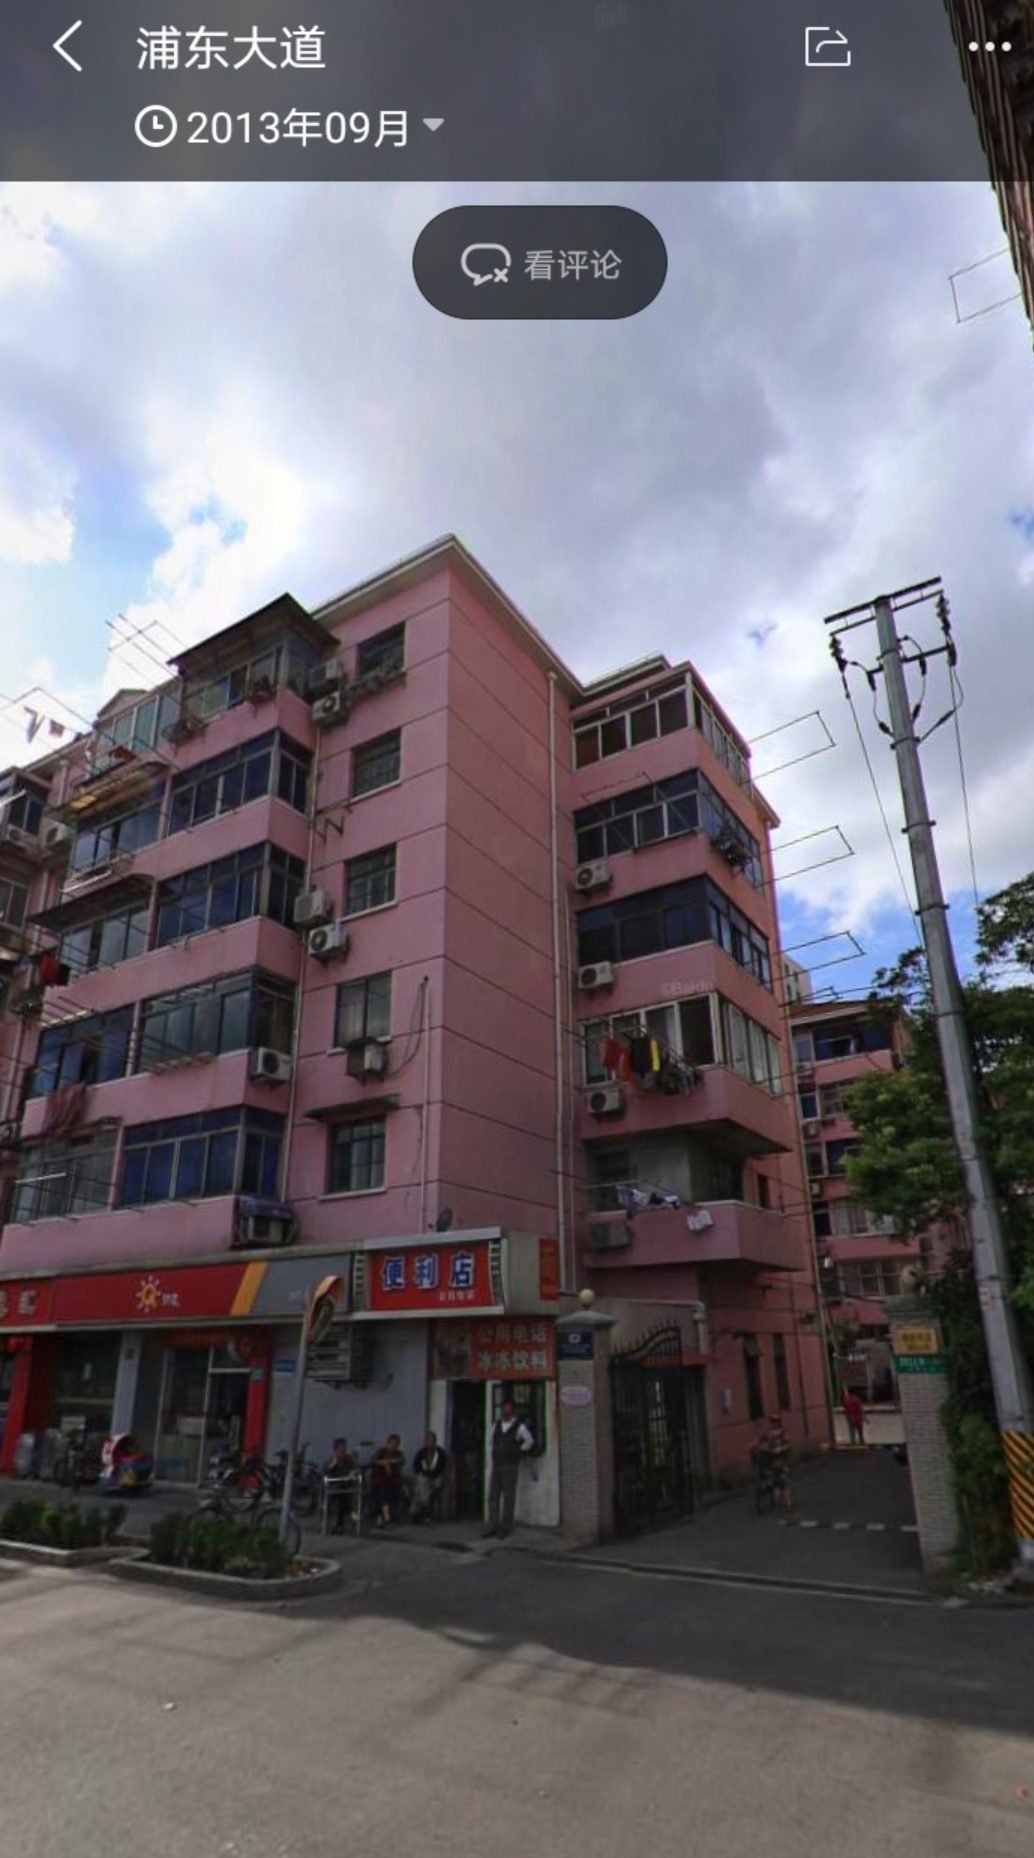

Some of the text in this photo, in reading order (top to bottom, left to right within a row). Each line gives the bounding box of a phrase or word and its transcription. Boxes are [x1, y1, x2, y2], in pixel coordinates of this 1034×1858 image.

[381, 1251, 475, 1291] 便利店
[478, 1325, 547, 1345] 公用电话
[478, 1352, 548, 1374] 冰冻饮料
